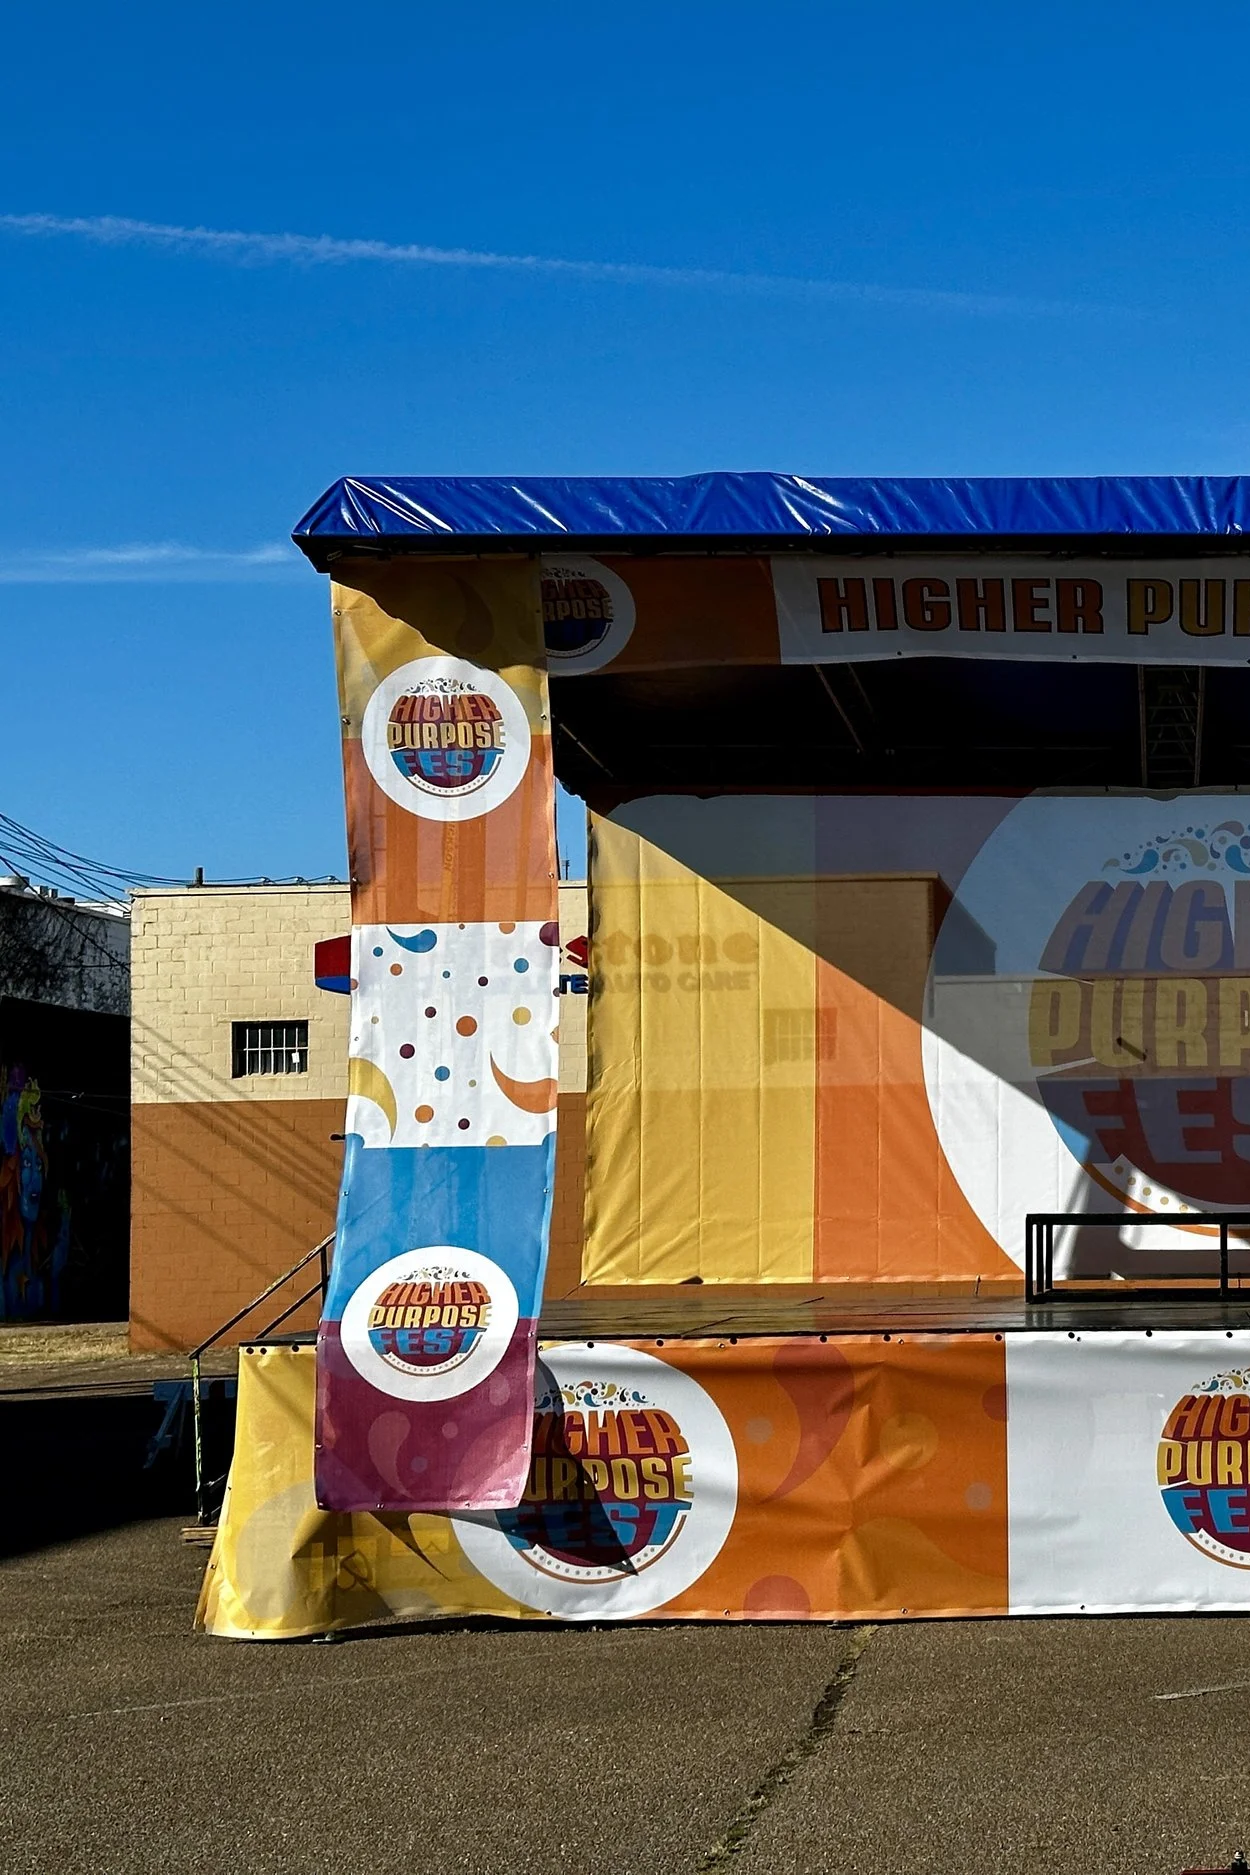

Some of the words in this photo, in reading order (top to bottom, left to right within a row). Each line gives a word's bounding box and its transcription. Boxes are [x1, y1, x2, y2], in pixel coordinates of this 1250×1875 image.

[545, 598, 614, 622] RPOSE
[816, 577, 1104, 634] HIGHER
[388, 693, 503, 721] HIGHER
[387, 721, 506, 749] PURPOSE
[390, 748, 505, 777] FEST
[374, 1281, 492, 1305] HIGHER
[367, 1304, 492, 1329] PURPOSE
[368, 1327, 487, 1355] FEST
[532, 1409, 690, 1456] IGHER
[523, 1456, 695, 1500] URPOSE
